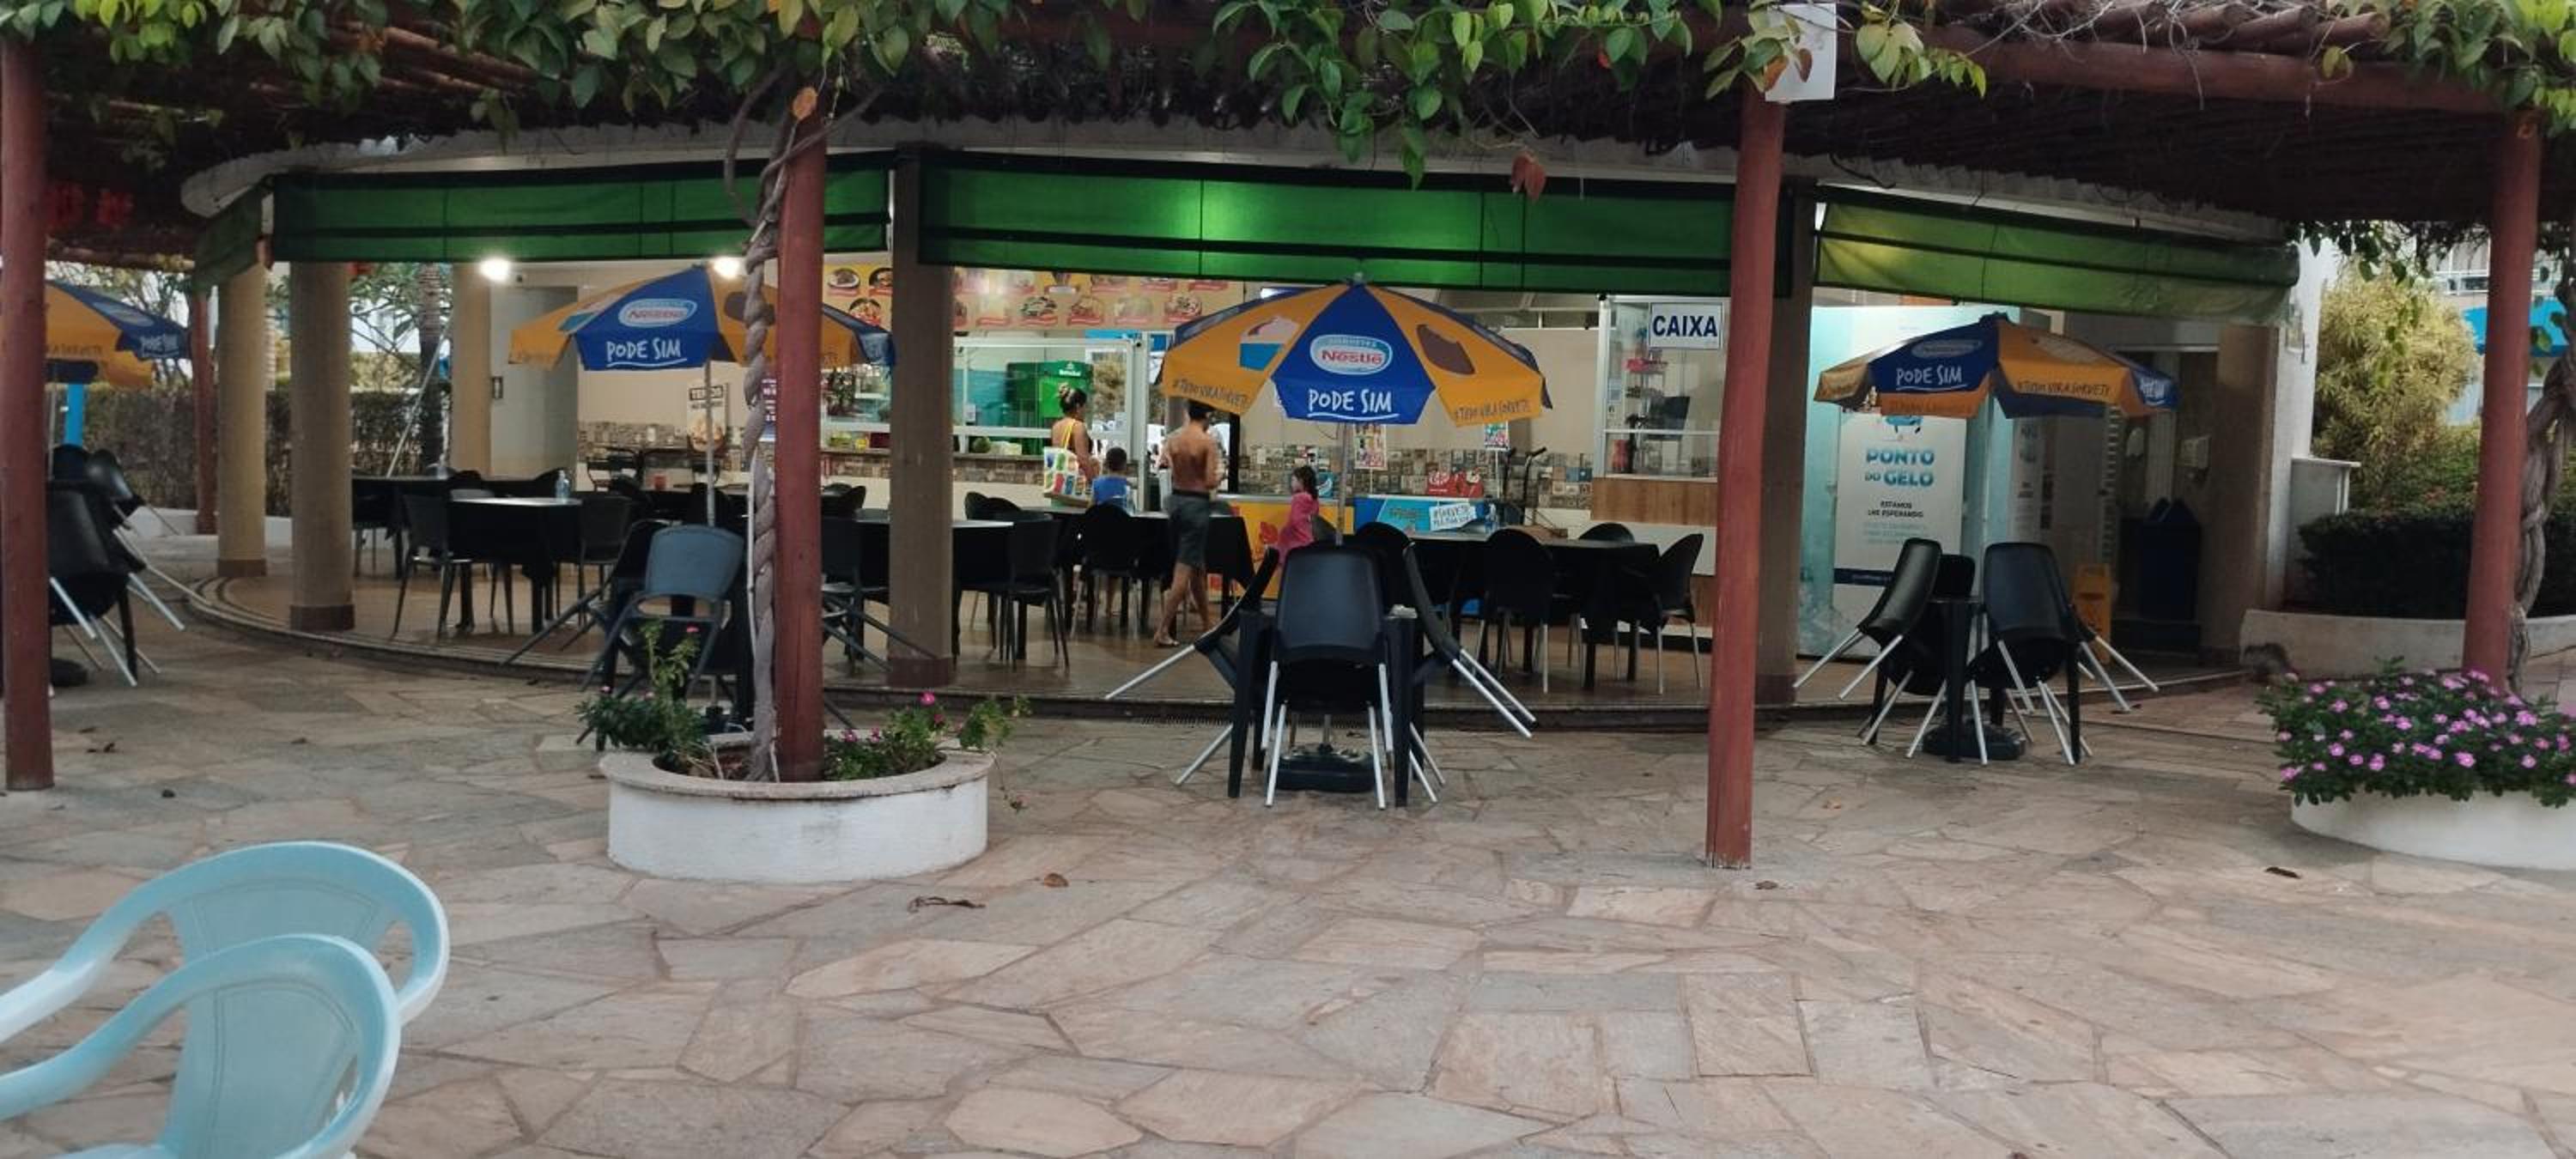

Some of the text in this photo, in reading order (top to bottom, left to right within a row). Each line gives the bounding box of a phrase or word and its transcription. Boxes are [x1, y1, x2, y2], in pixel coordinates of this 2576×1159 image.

[1653, 315, 1717, 337] CAIXA
[605, 337, 681, 361] PODE SIM
[1896, 365, 1962, 385] PODE SIM
[1308, 388, 1392, 414] PODE SIM
[1867, 450, 1935, 465] PONTO
[1865, 471, 1935, 488] DO GELO
